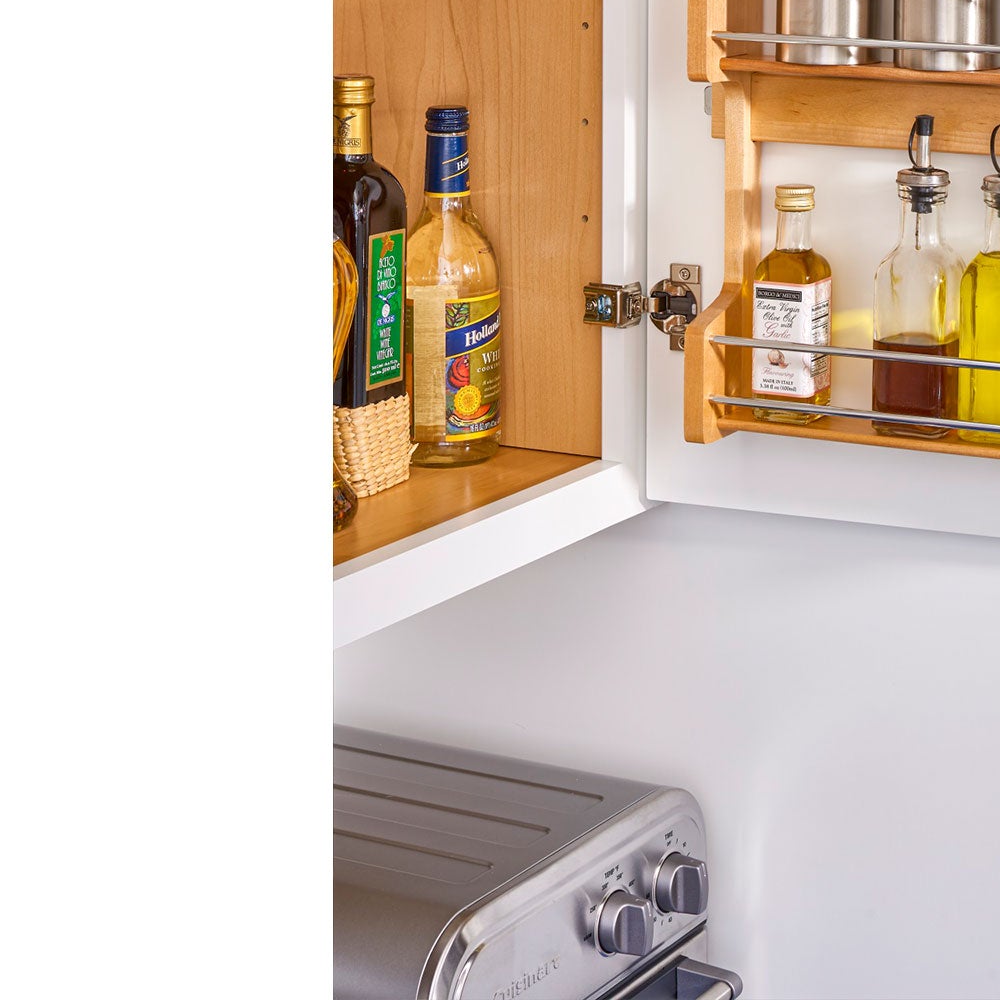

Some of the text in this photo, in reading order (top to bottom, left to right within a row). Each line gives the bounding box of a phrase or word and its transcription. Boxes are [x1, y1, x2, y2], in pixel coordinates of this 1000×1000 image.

[756, 300, 800, 313] Extra Virgin
[762, 312, 796, 323] Olive Oil
[762, 322, 791, 338] Garlic
